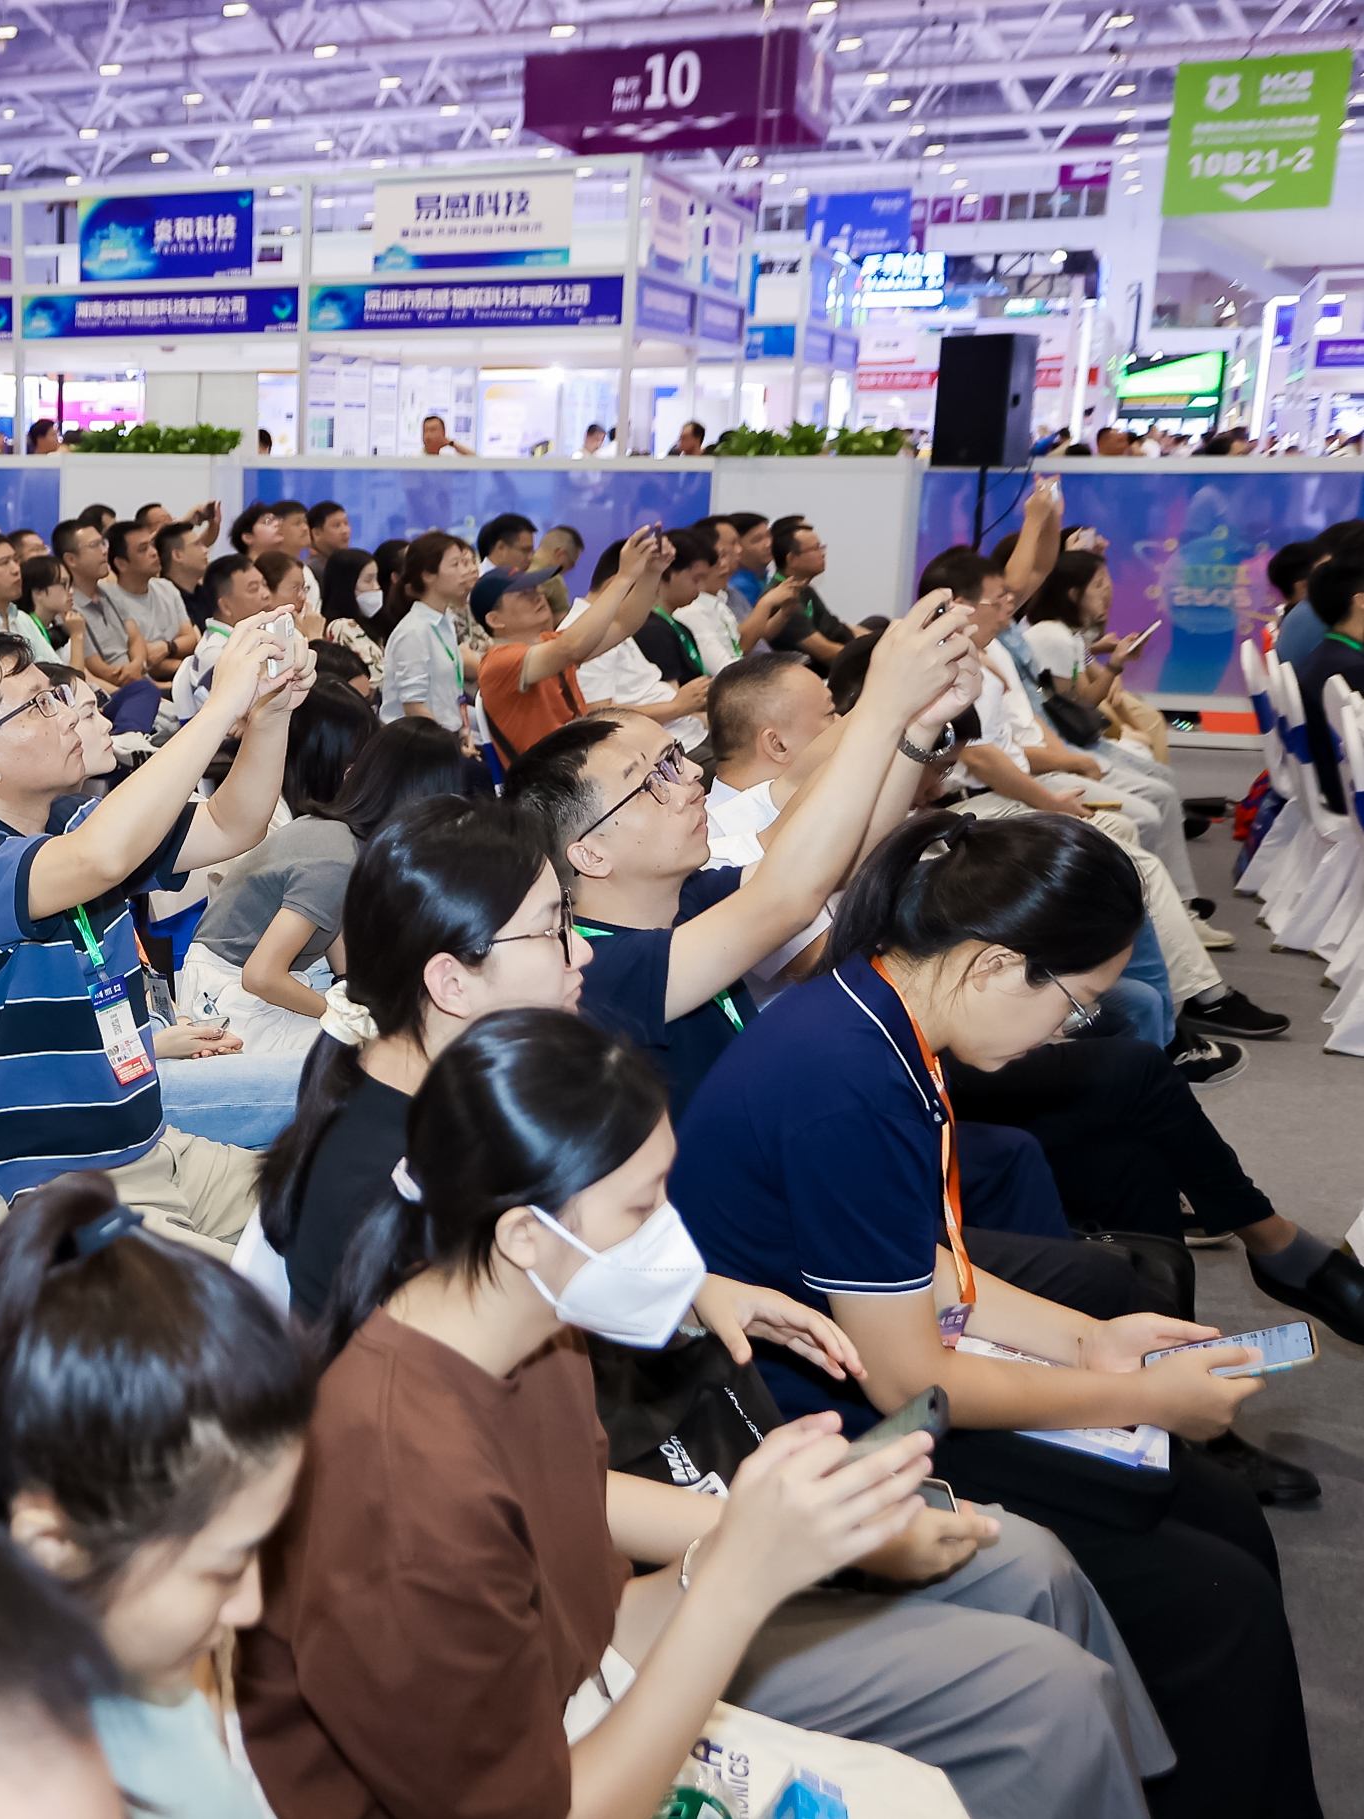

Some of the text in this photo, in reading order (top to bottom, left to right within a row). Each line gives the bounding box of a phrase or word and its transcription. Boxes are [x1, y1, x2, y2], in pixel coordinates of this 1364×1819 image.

[643, 50, 702, 111] 10
[1188, 146, 1316, 179] 10B21-2
[414, 190, 531, 221] 易感科技
